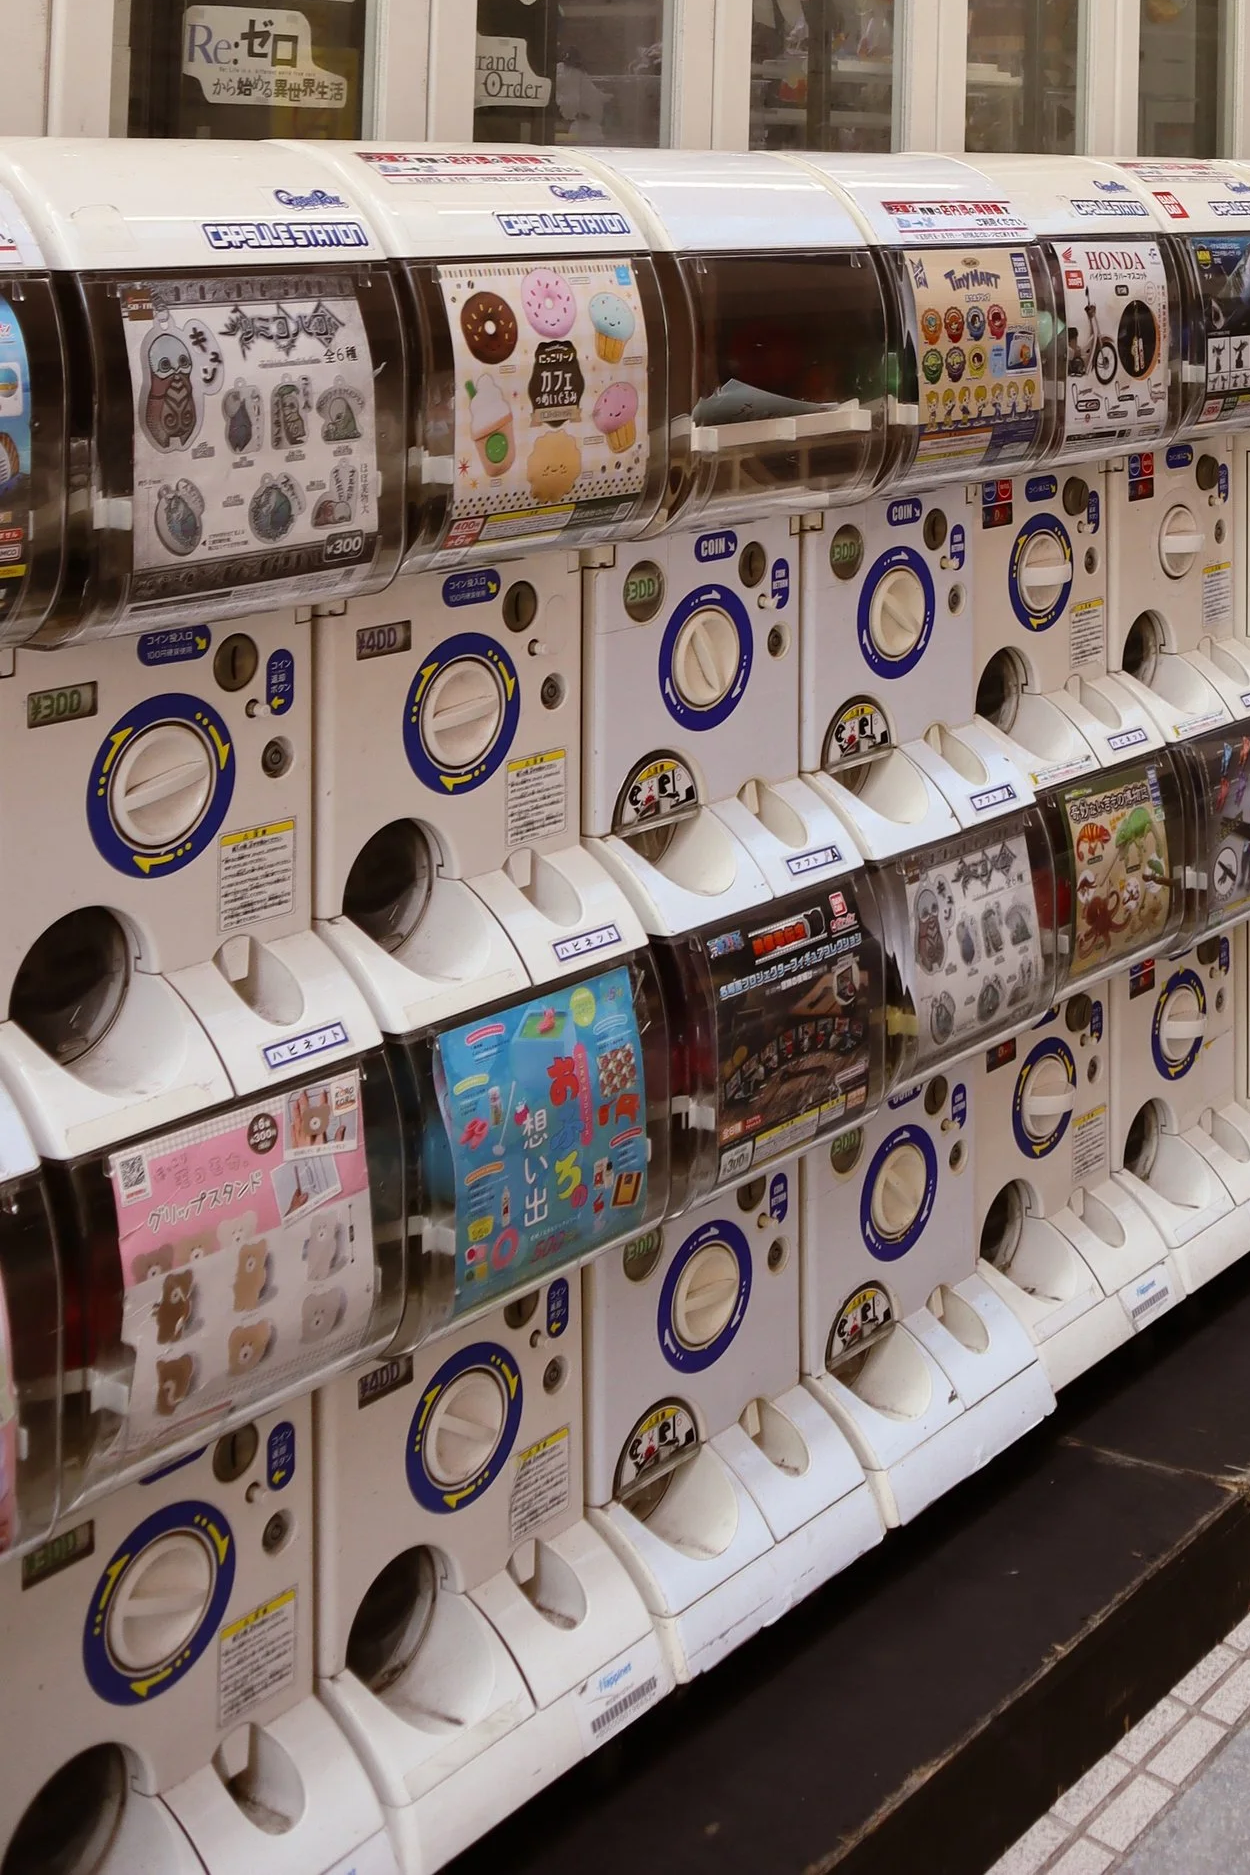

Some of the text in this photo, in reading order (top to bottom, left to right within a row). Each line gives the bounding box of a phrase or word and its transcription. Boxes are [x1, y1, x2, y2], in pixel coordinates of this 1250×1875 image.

[187, 18, 299, 68] Re:ゼロ
[212, 76, 344, 104] から始める異世界生活
[482, 71, 543, 100] Order
[1084, 250, 1146, 270] HONDA
[188, 327, 223, 384] キュン
[323, 345, 359, 364] 全6種
[540, 370, 574, 393] カフェ
[892, 507, 913, 522] COIN
[326, 537, 362, 556] ¥300
[700, 539, 727, 558] COIN
[449, 577, 487, 591] コイン投入口
[146, 631, 193, 646] コイン投入口
[357, 627, 398, 654] ¥400
[271, 659, 292, 671] コイン
[30, 689, 83, 721] ¥300
[522, 1108, 549, 1228] 想い出
[148, 1171, 264, 1233] グリップスタンド
